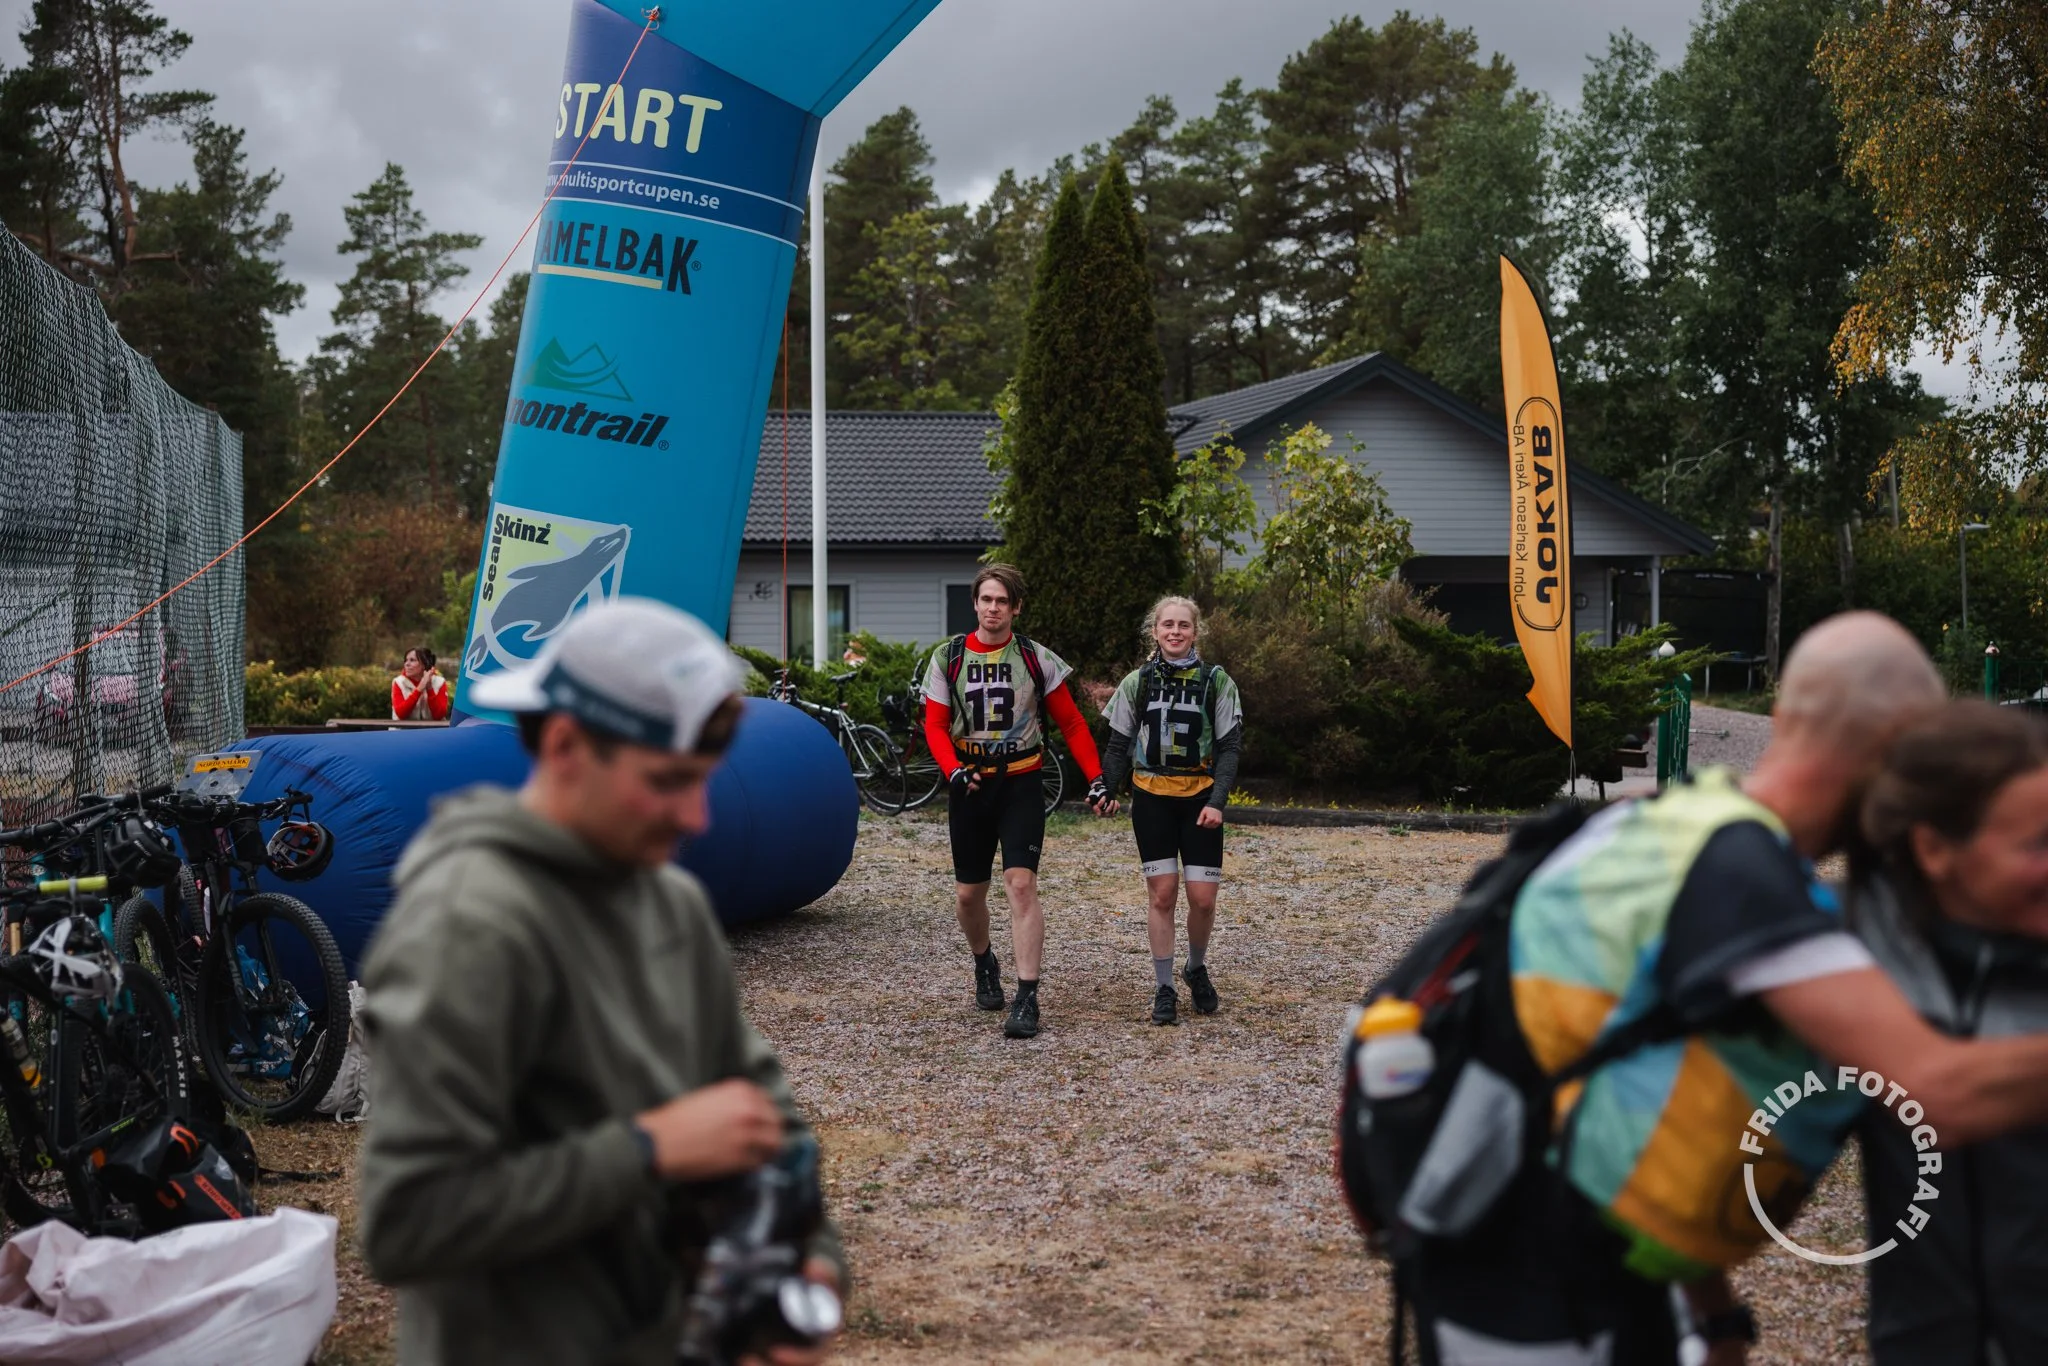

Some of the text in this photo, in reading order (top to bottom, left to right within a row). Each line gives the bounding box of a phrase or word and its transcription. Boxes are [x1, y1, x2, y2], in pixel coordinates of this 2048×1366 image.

[555, 83, 723, 154] START
[540, 220, 699, 295] AMELBAK
[967, 663, 1012, 683] ÖAR
[965, 687, 1015, 732] 13
[1146, 707, 1200, 768] 13
[171, 1035, 187, 1098] MAXXIS
